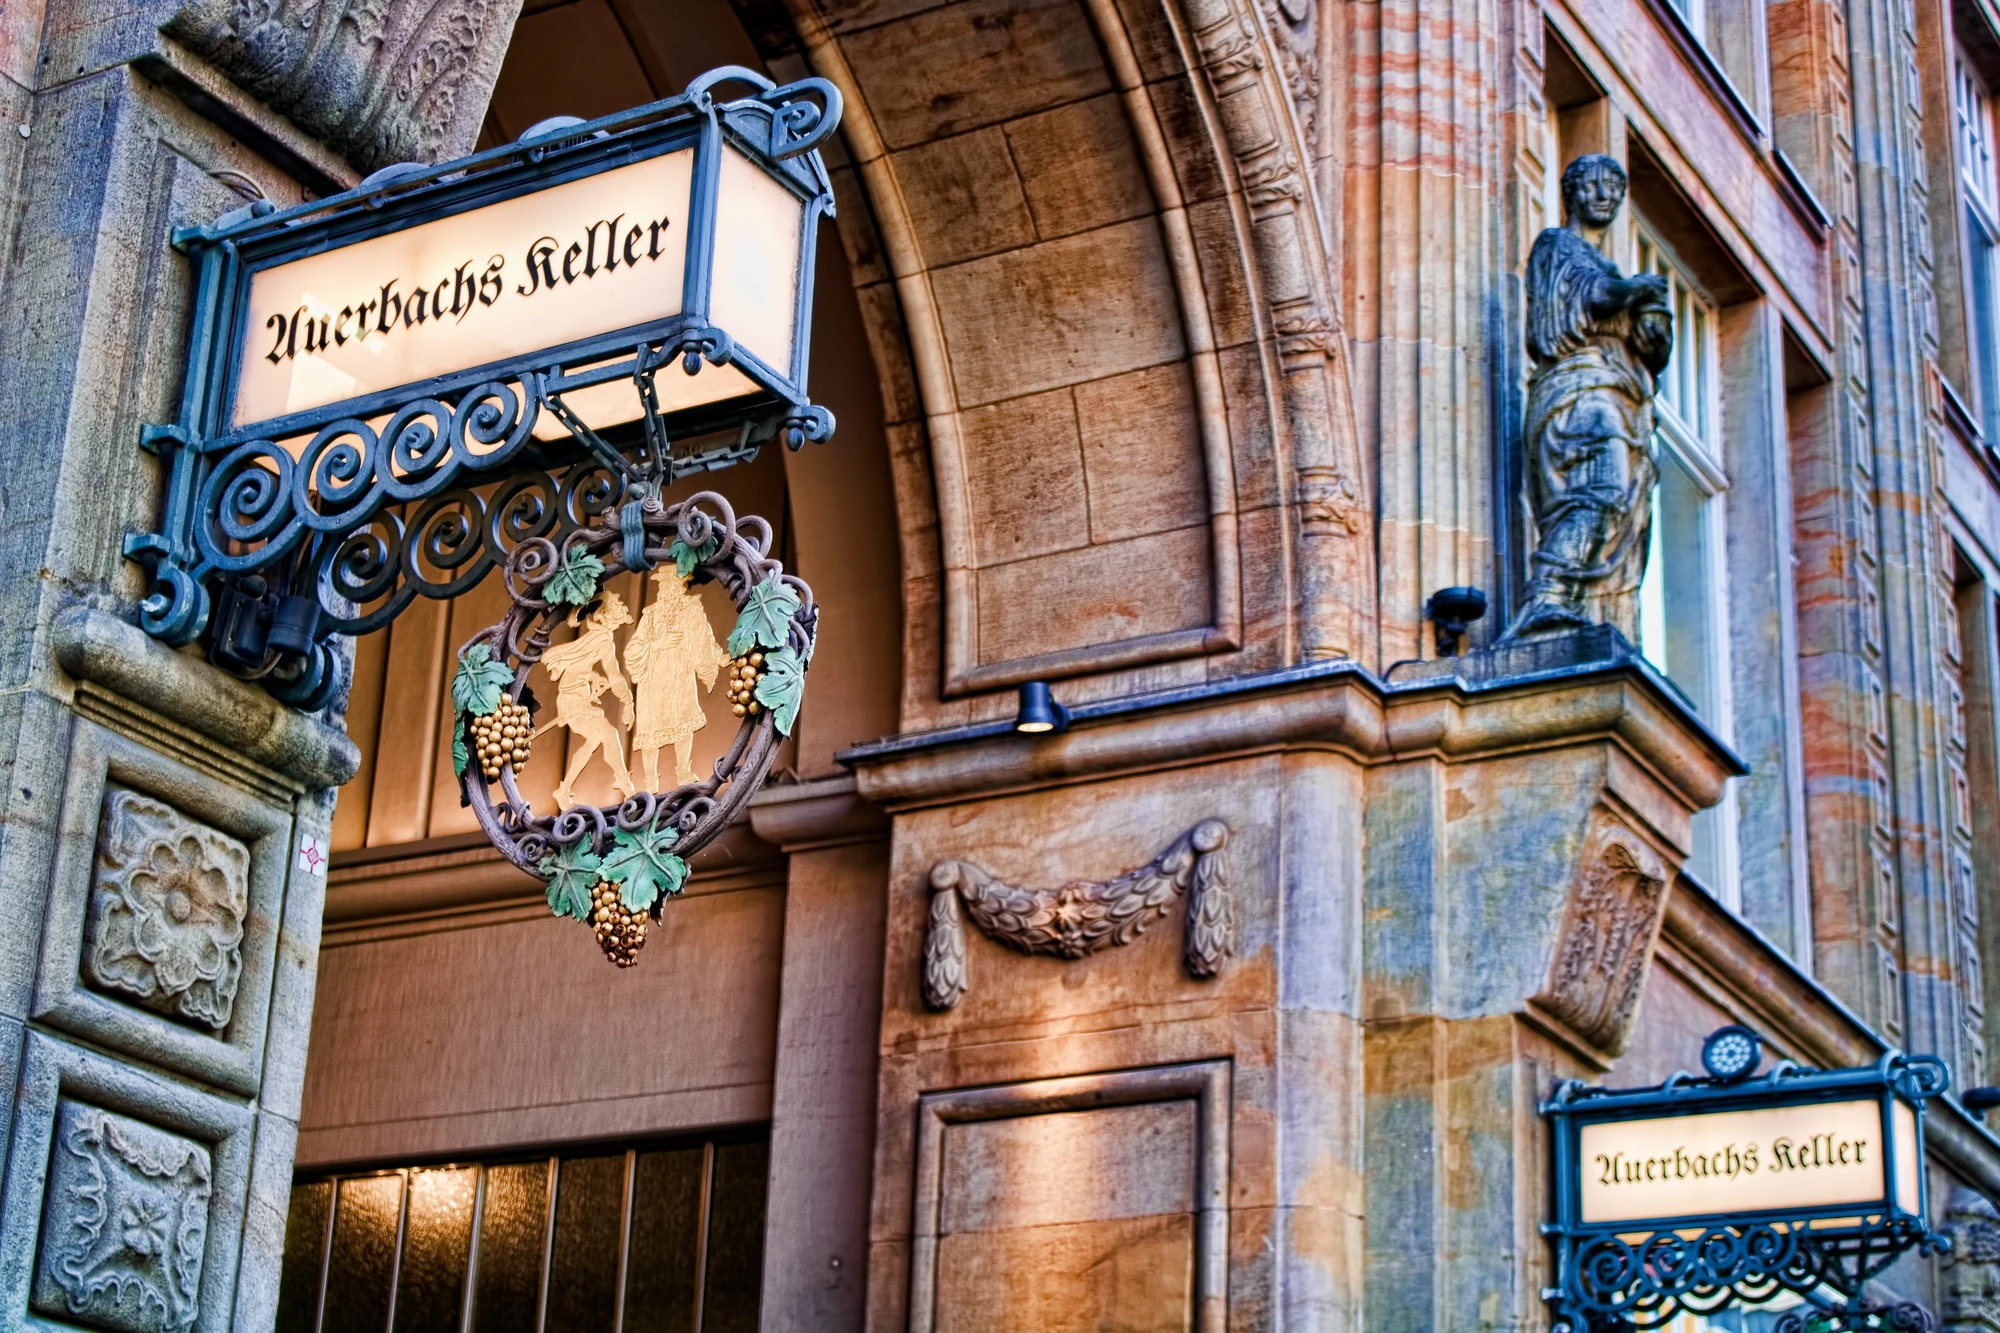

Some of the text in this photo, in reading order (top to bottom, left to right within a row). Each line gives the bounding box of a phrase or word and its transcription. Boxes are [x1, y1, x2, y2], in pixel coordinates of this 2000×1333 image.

[265, 213, 671, 365] Auerbachs Keller
[1596, 1133, 1868, 1185] Auerbachs Keller
